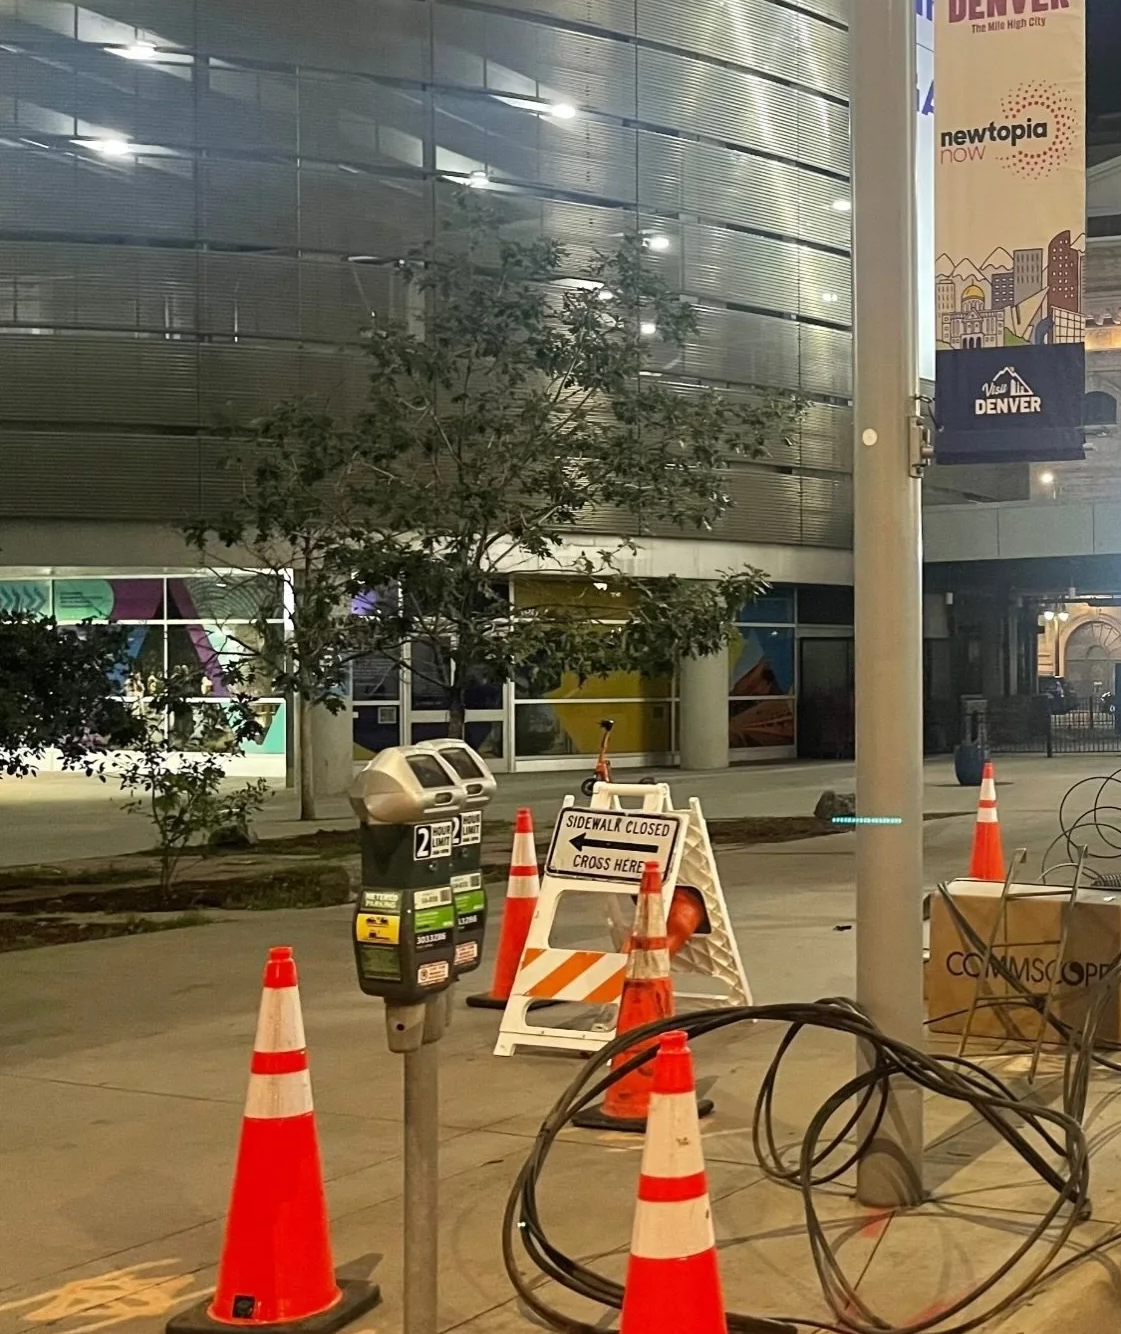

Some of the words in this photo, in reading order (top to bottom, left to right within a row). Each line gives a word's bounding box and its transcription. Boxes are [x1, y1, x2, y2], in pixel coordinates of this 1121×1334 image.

[972, 24, 987, 34] The
[988, 20, 1005, 32] Mile
[1007, 18, 1027, 30] High
[1029, 17, 1046, 28] City
[940, 118, 1048, 148] newtopia
[940, 145, 987, 164] now
[982, 382, 1007, 397] Visit
[975, 396, 1041, 414] DENVER
[463, 825, 479, 835] LIMIT
[566, 815, 622, 833] SIDEWALK
[625, 820, 670, 837] CLOSED
[416, 827, 430, 858] 2
[432, 836, 450, 848] LIMIT
[573, 855, 611, 870] CROSS
[614, 858, 645, 874] HERE
